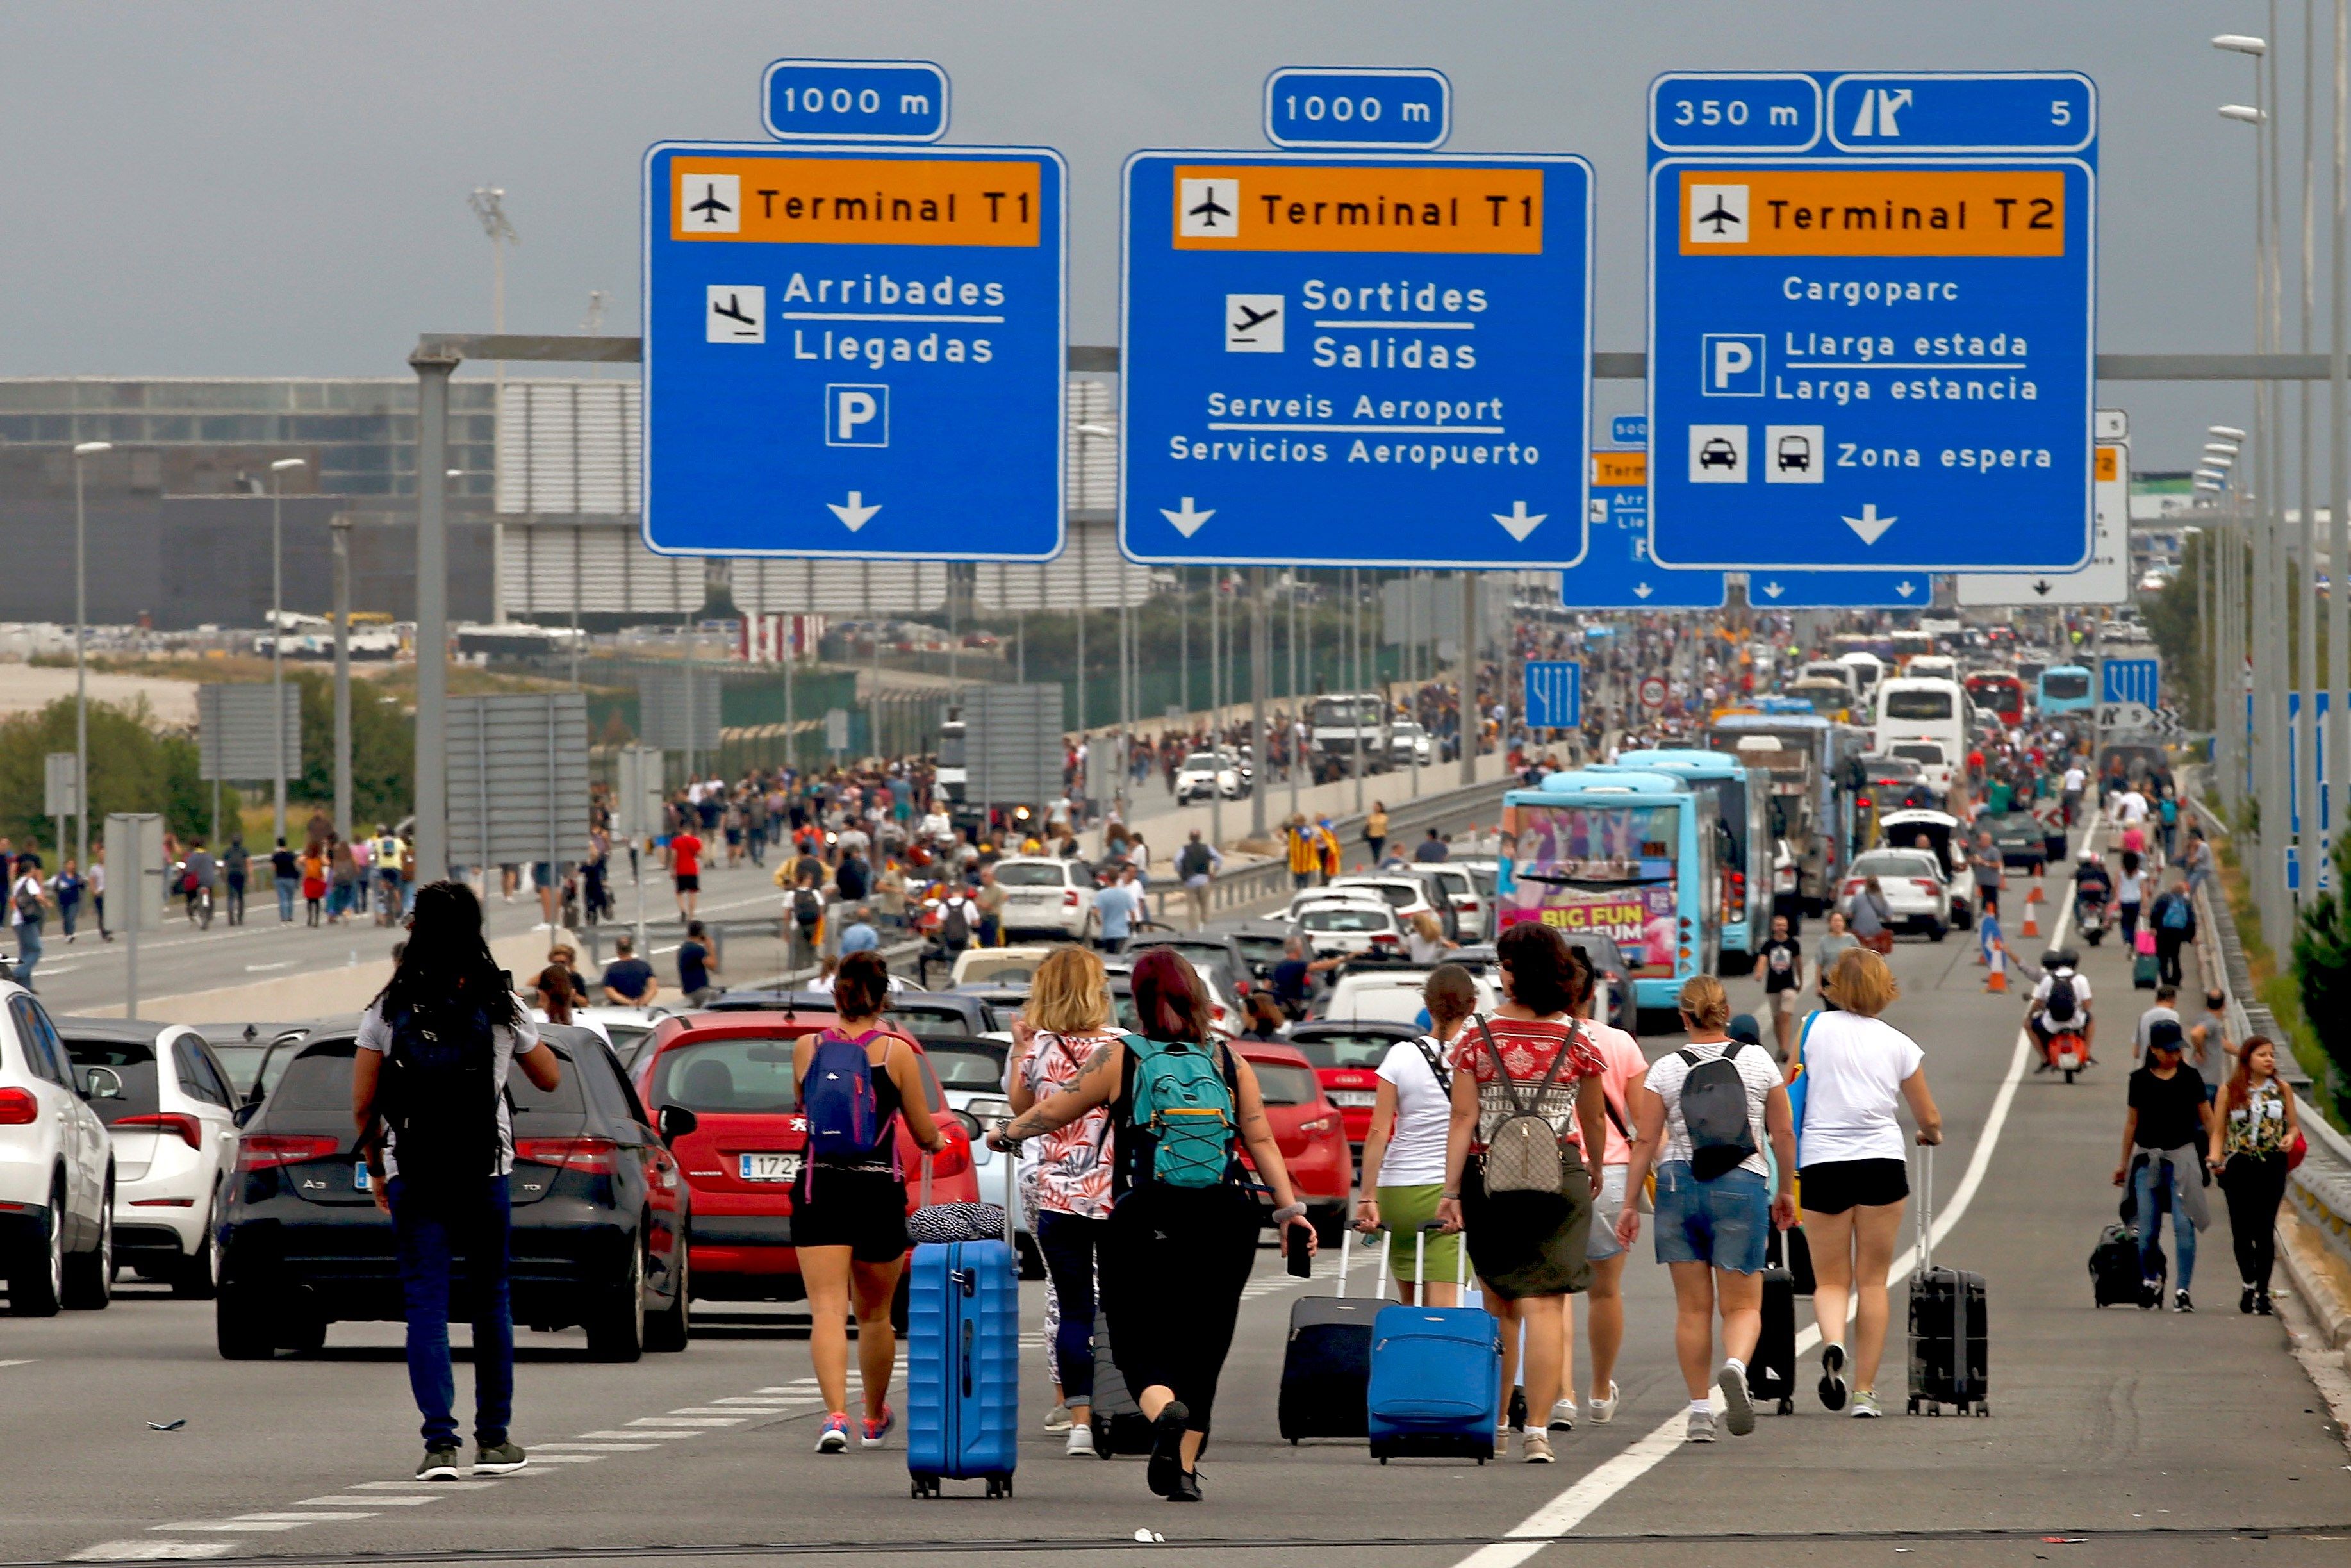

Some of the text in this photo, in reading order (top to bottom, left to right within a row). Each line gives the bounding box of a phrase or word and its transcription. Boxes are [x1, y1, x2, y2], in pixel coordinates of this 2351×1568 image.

[785, 87, 930, 114] 1000 m
[1287, 95, 1430, 122] 1000 m
[1674, 99, 1798, 126] 350 m
[2051, 100, 2071, 126] 5
[757, 190, 1028, 224] Terminal T1
[1261, 195, 1532, 227] Terminal T1
[1767, 198, 2054, 230] Terminal T2
[783, 272, 1005, 306] Arribades
[1302, 279, 1488, 312] Sortides
[1783, 276, 1958, 307] Cargoparc
[795, 329, 993, 370] Llegadas
[1313, 336, 1476, 370] Salidas
[1785, 331, 2027, 362] Llarga estada
[1714, 342, 1753, 388] P
[1776, 375, 2038, 406] Larga estancia
[838, 392, 877, 440] P
[1208, 392, 1503, 425] Serveis Aeroport
[1169, 435, 1539, 470] Servicios Aeropuerto
[1836, 442, 2052, 473] Zona espera
[1541, 904, 1644, 927] BIG FUN
[302, 1178, 327, 1189] A3
